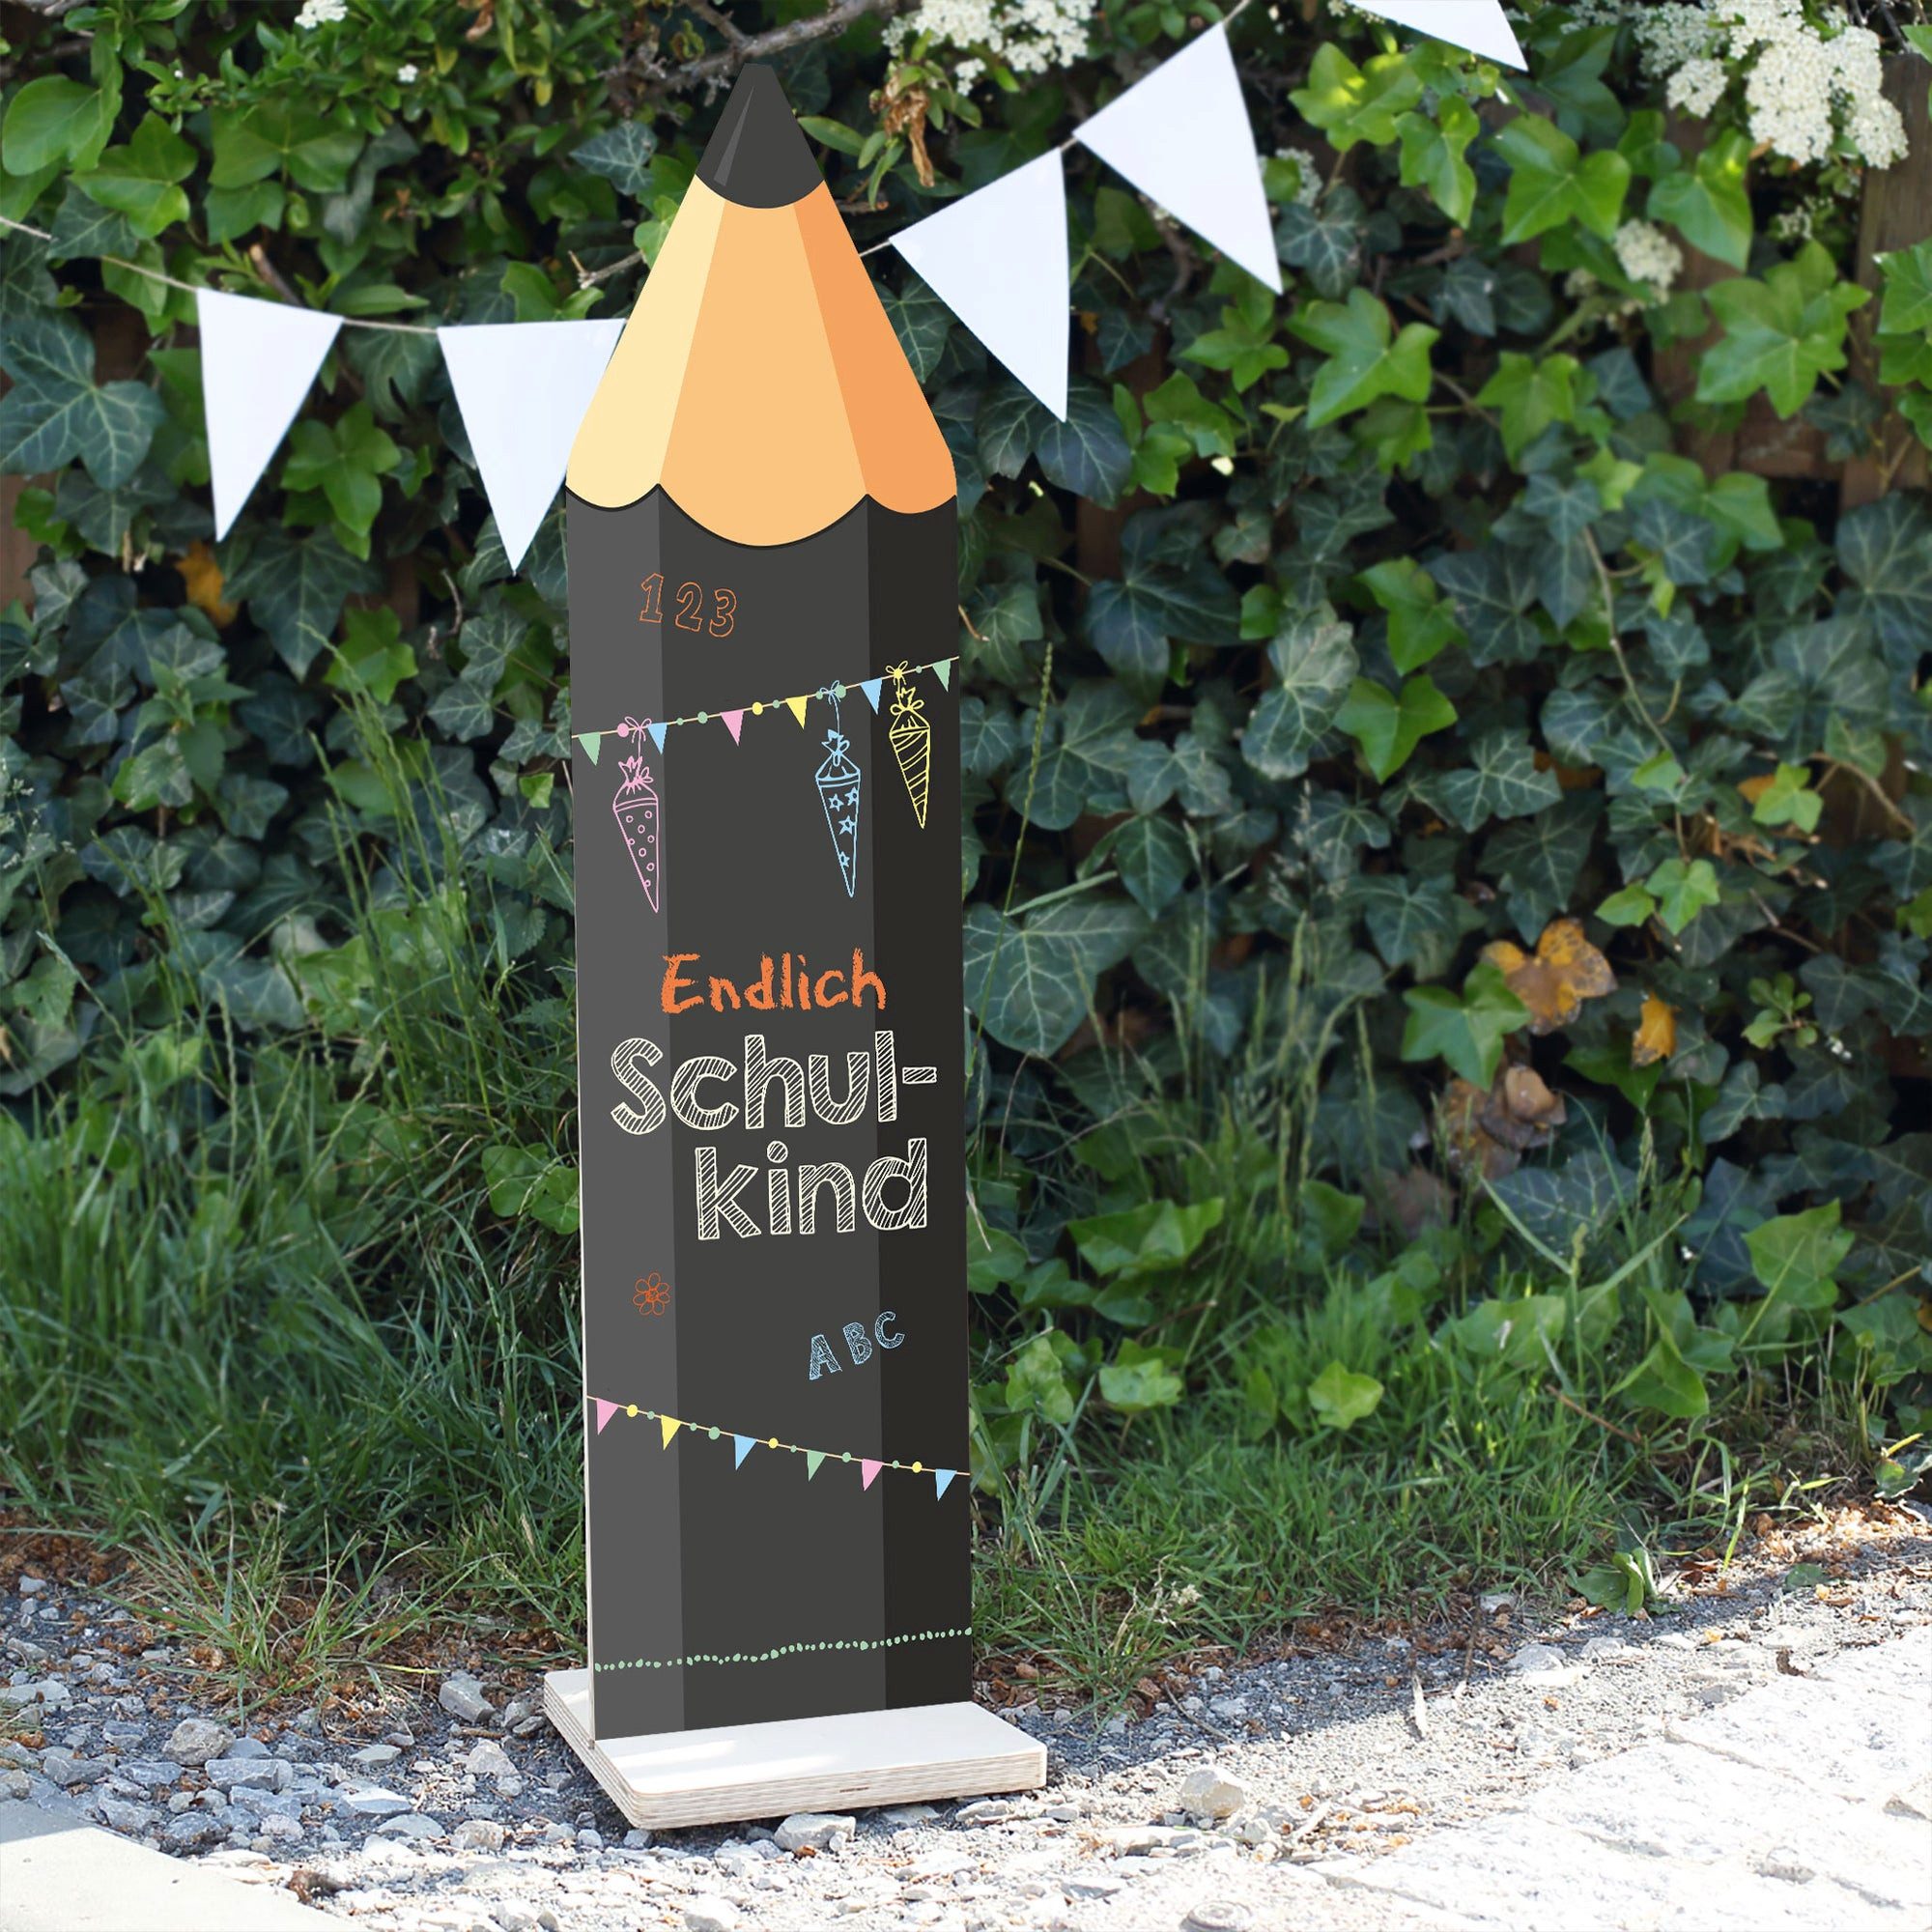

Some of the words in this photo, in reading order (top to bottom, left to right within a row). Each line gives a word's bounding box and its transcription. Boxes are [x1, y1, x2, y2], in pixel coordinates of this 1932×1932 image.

[661, 948, 887, 1013] Endlich
[611, 1030, 937, 1135] Schul-
[696, 1138, 927, 1240] kind
